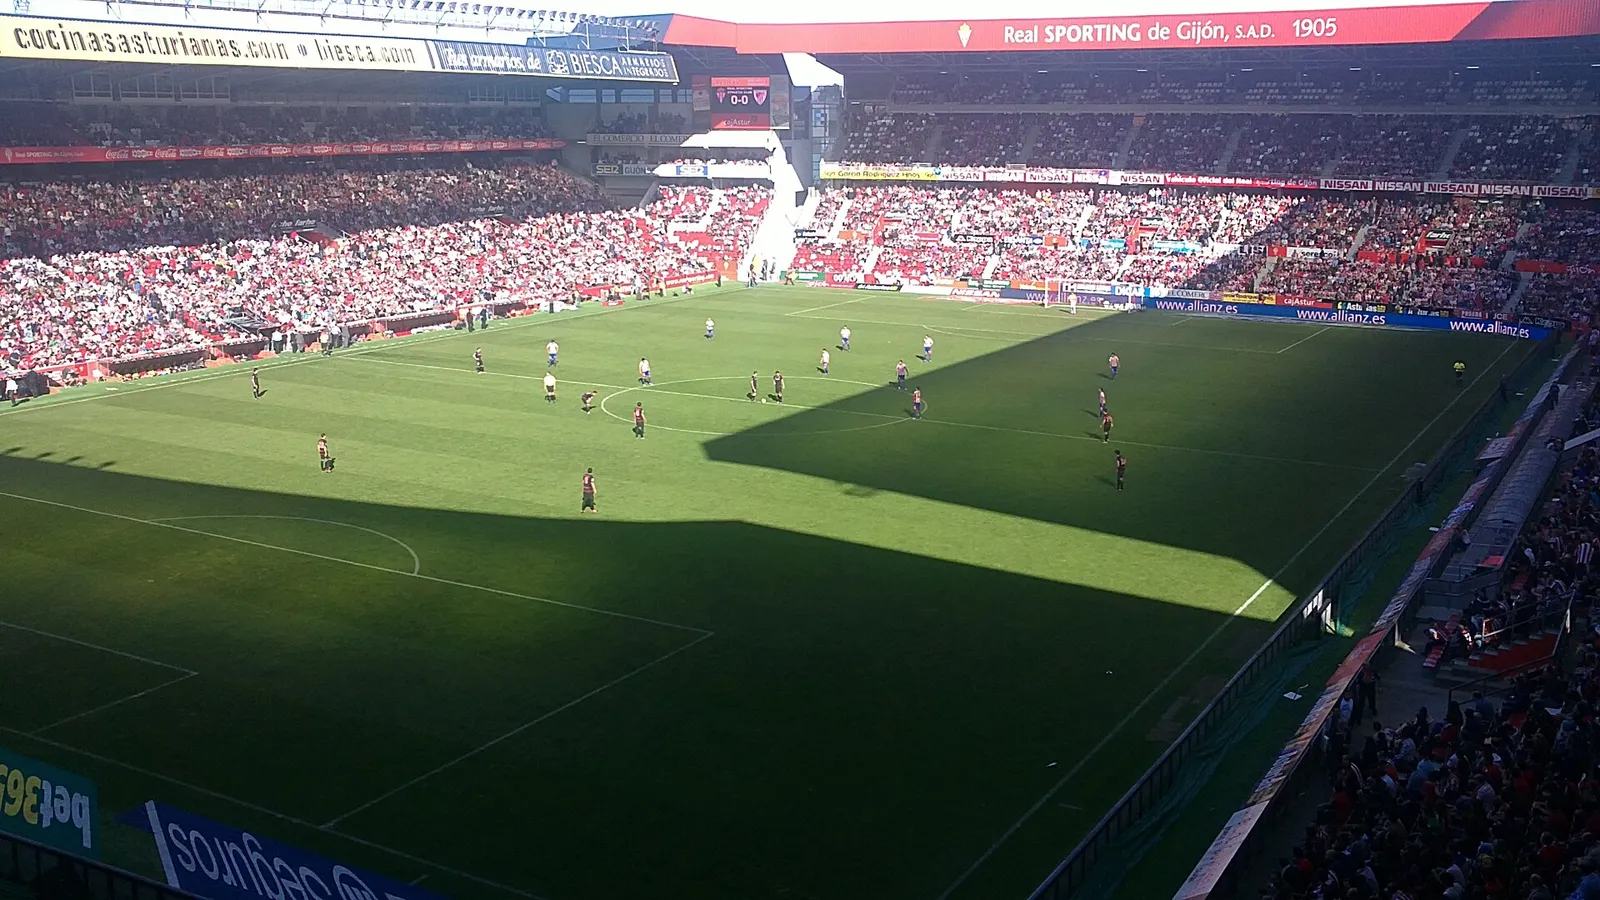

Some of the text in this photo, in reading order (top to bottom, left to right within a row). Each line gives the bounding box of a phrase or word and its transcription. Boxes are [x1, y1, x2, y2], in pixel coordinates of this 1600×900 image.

[1004, 18, 1338, 44] Real SPORTING de Gijón, S.A.D. 1905
[569, 53, 622, 75] BIESCA
[730, 94, 749, 105] 0-0
[723, 119, 750, 127] cajAstur
[1029, 173, 1069, 181] NISSAN
[1120, 175, 1160, 183] NISSAN
[1324, 180, 1369, 190] NISSAN
[1375, 181, 1421, 191] NISSAN
[1427, 183, 1474, 193] NISSAN
[1481, 184, 1529, 195] NISSAN
[1537, 186, 1588, 197] NISSAN
[1176, 290, 1207, 299] COMERC
[1155, 300, 1238, 314] www.allianz.es
[1283, 297, 1315, 307] cajAstur
[1346, 302, 1377, 312] Astuias
[1296, 309, 1386, 325] www.allianz.es
[1450, 320, 1530, 339] www.allianz.es
